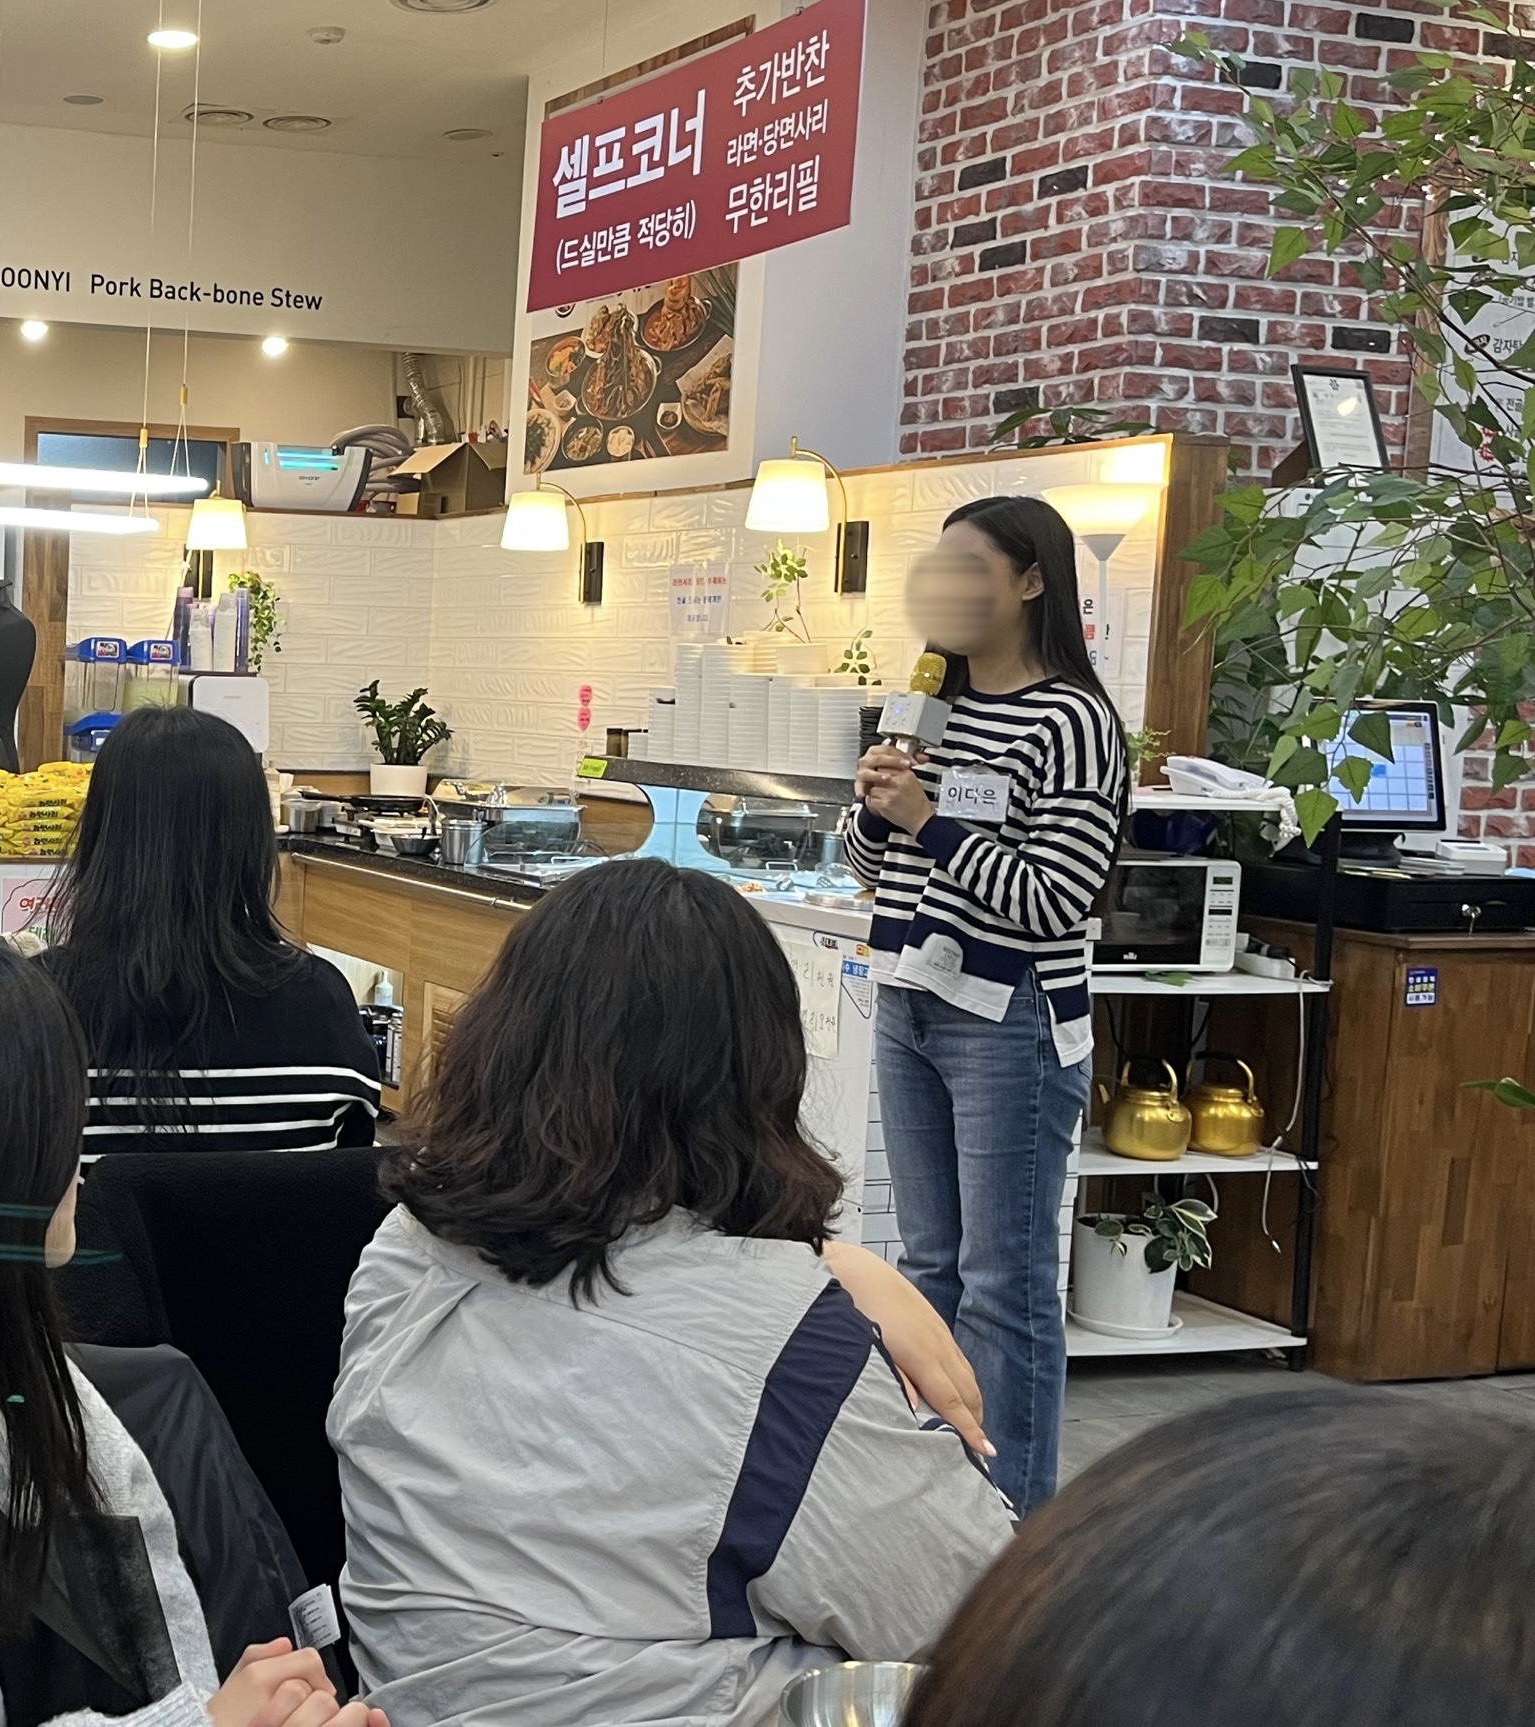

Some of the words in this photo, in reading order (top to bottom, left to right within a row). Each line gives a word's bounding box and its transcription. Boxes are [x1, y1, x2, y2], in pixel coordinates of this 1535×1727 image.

[733, 29, 830, 117] 추가반찬
[552, 88, 706, 219] 셀프코너
[725, 154, 821, 234] 무한리필
[555, 225, 631, 275] (드실만큼
[637, 199, 696, 250] 적당히)
[90, 273, 142, 298] Pork
[149, 278, 264, 306] Back-bone
[270, 287, 323, 311] Stew
